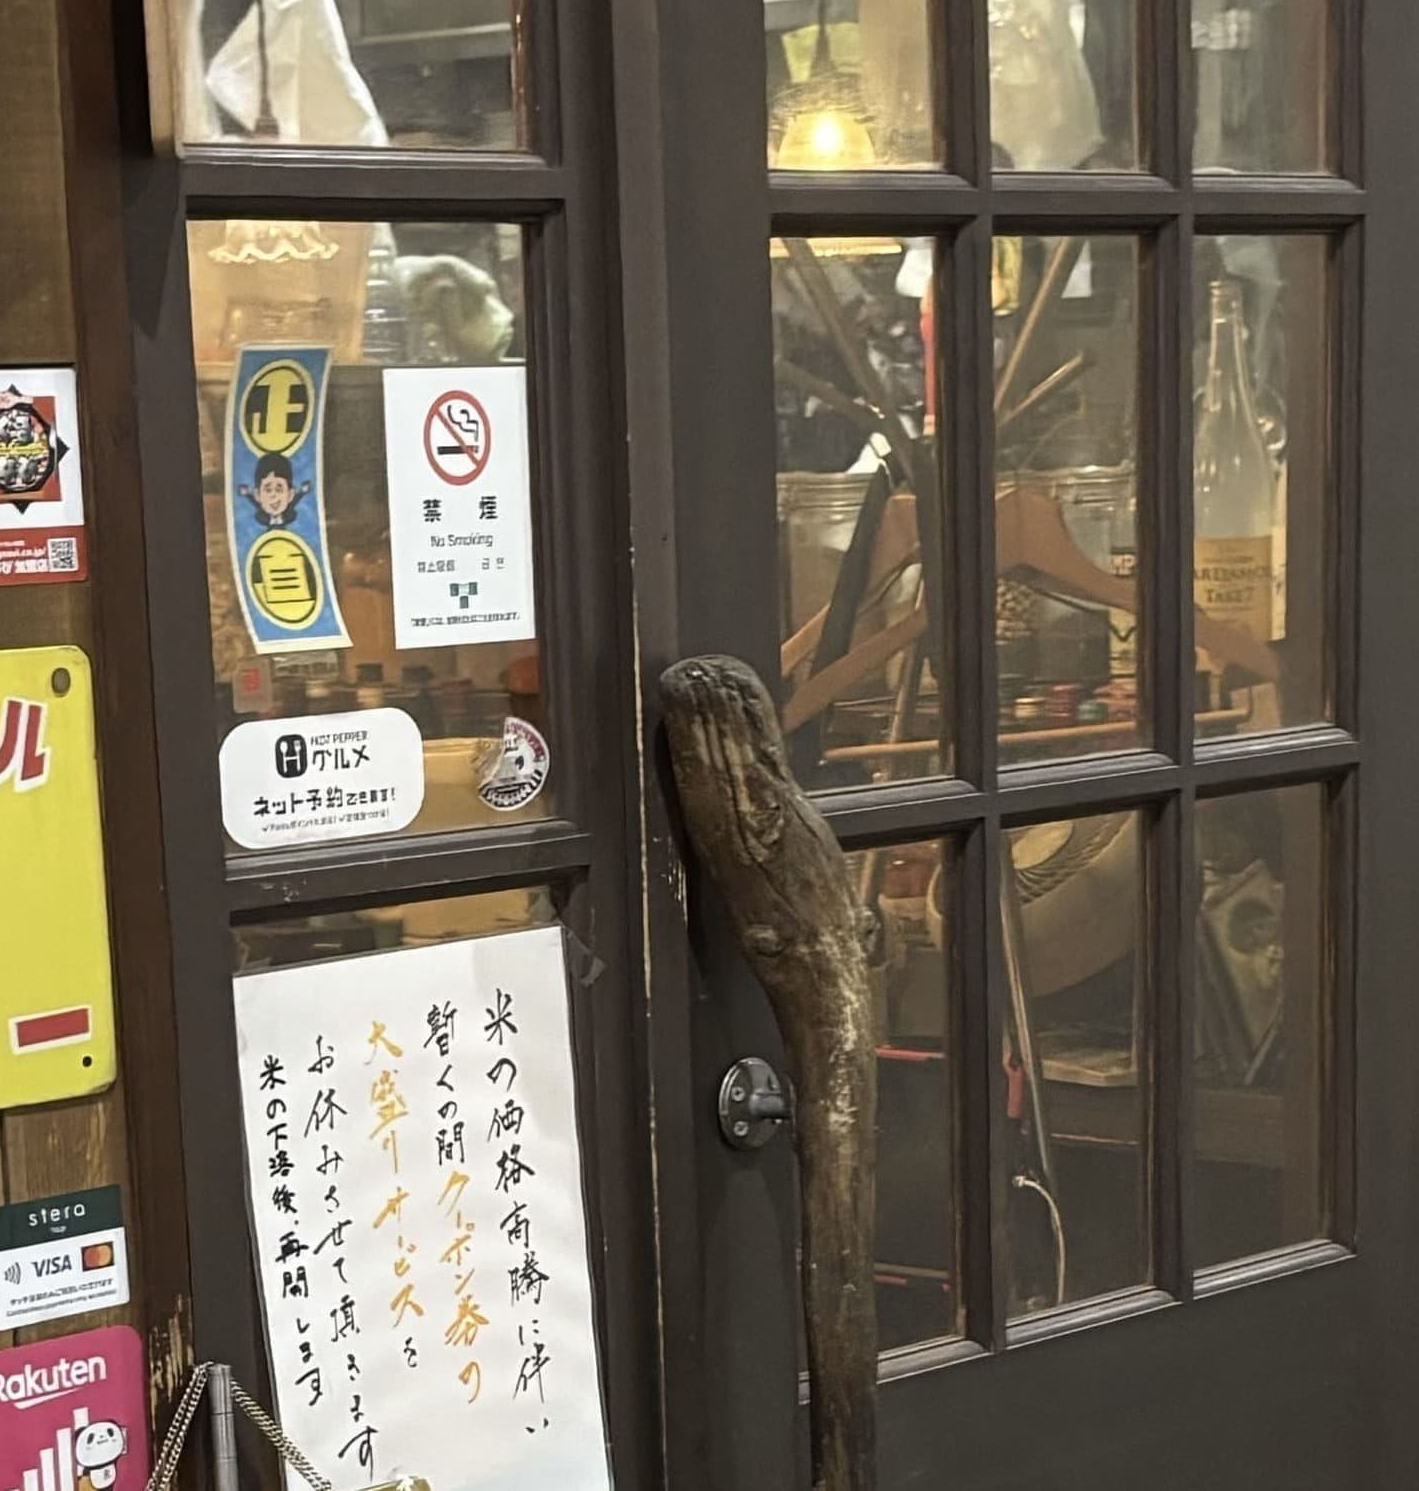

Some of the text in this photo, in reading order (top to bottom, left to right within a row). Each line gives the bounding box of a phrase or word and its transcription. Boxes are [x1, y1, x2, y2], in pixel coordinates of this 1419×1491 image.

[448, 532, 493, 547] Smoking
[312, 745, 371, 772] グルメ
[28, 1203, 86, 1227] stera
[32, 1254, 72, 1278] VISA
[303, 1034, 379, 1484] お休みさせて頂きます
